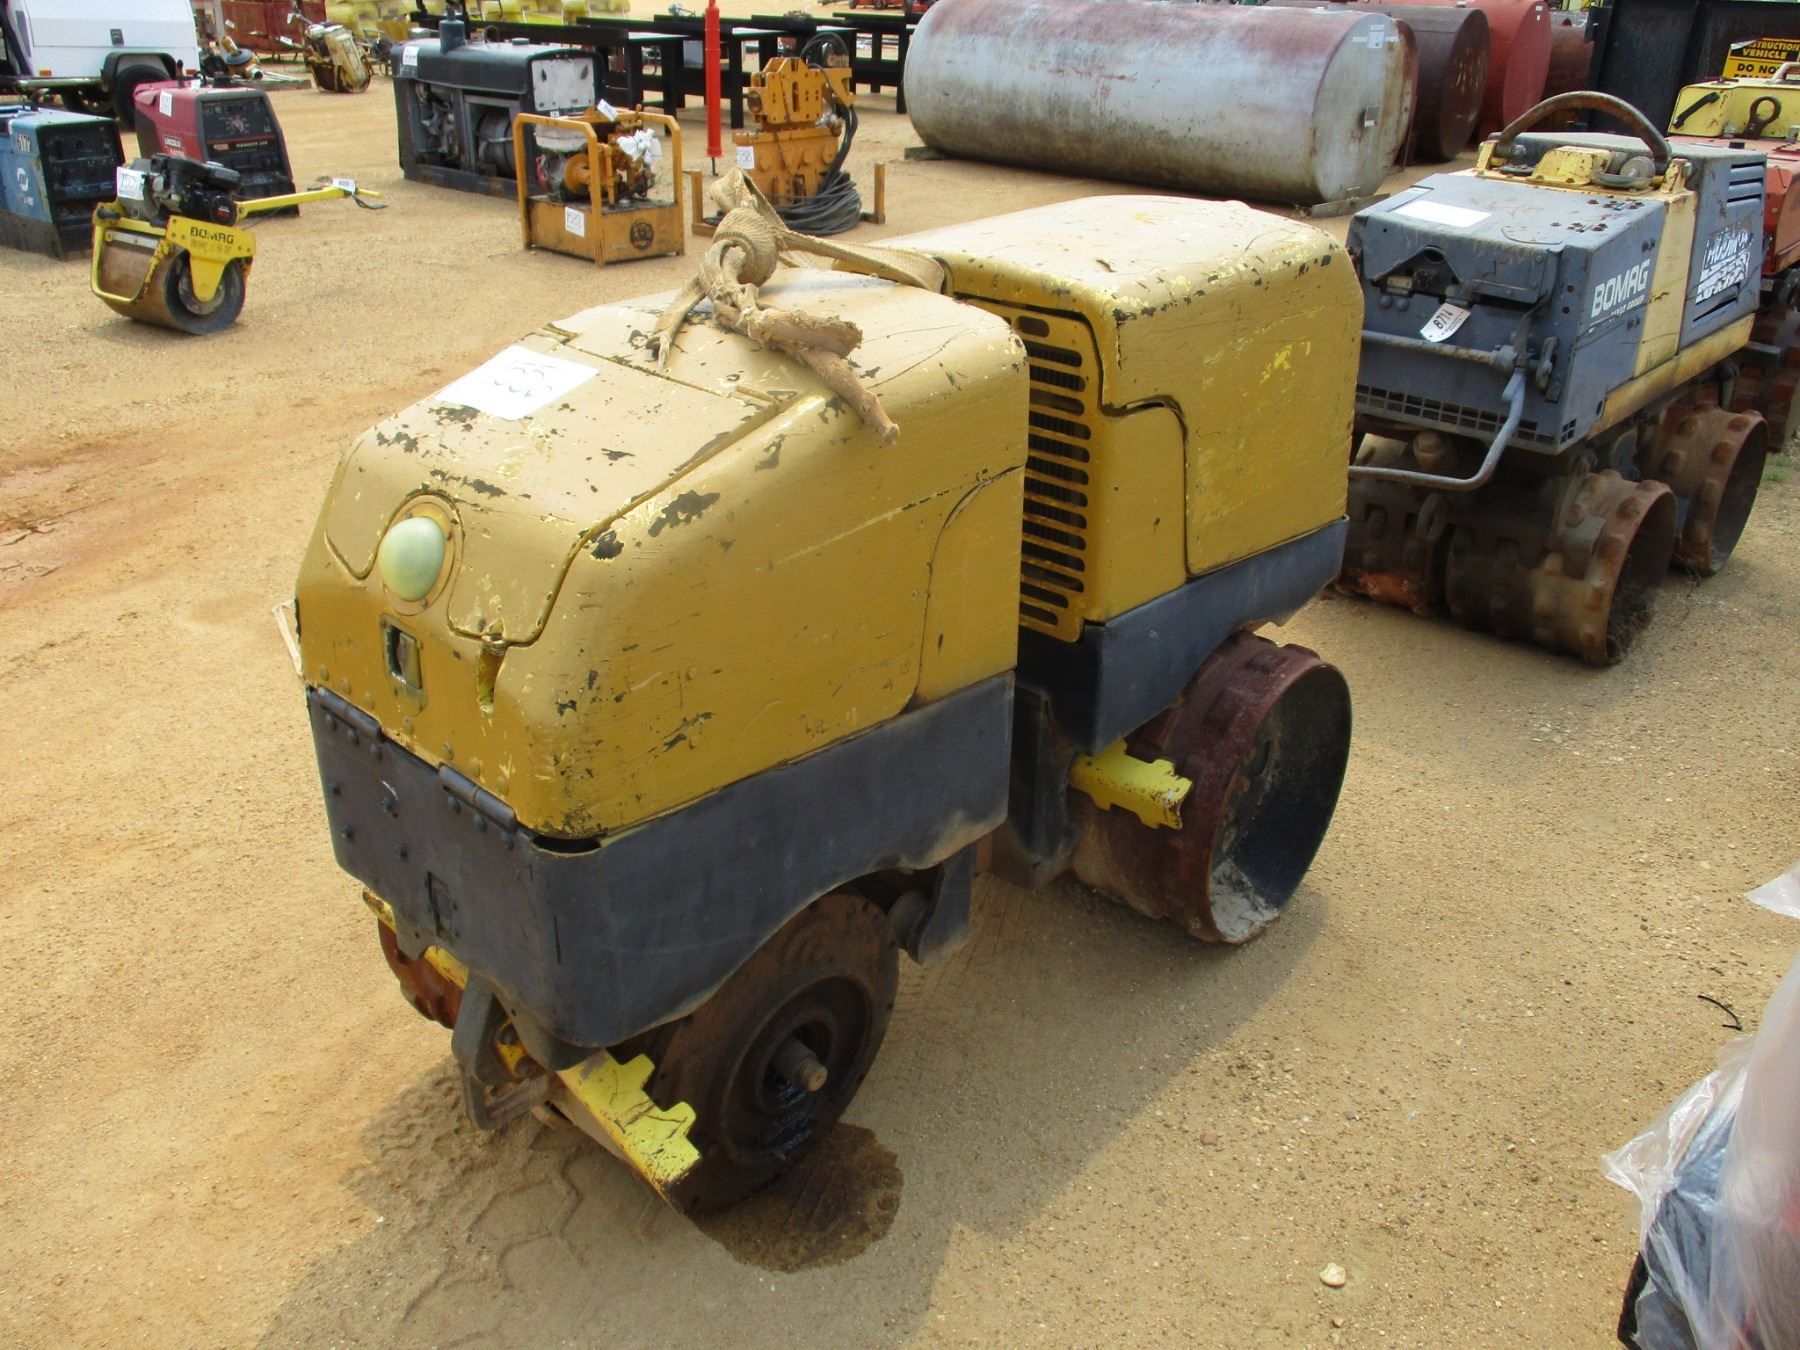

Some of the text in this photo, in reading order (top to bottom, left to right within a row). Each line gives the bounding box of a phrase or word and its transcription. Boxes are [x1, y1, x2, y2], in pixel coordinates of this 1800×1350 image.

[1742, 48, 1788, 59] VEHICLE
[1736, 63, 1780, 75] DO NO
[190, 226, 235, 244] BOMAG
[1591, 258, 1651, 318] BOMAG
